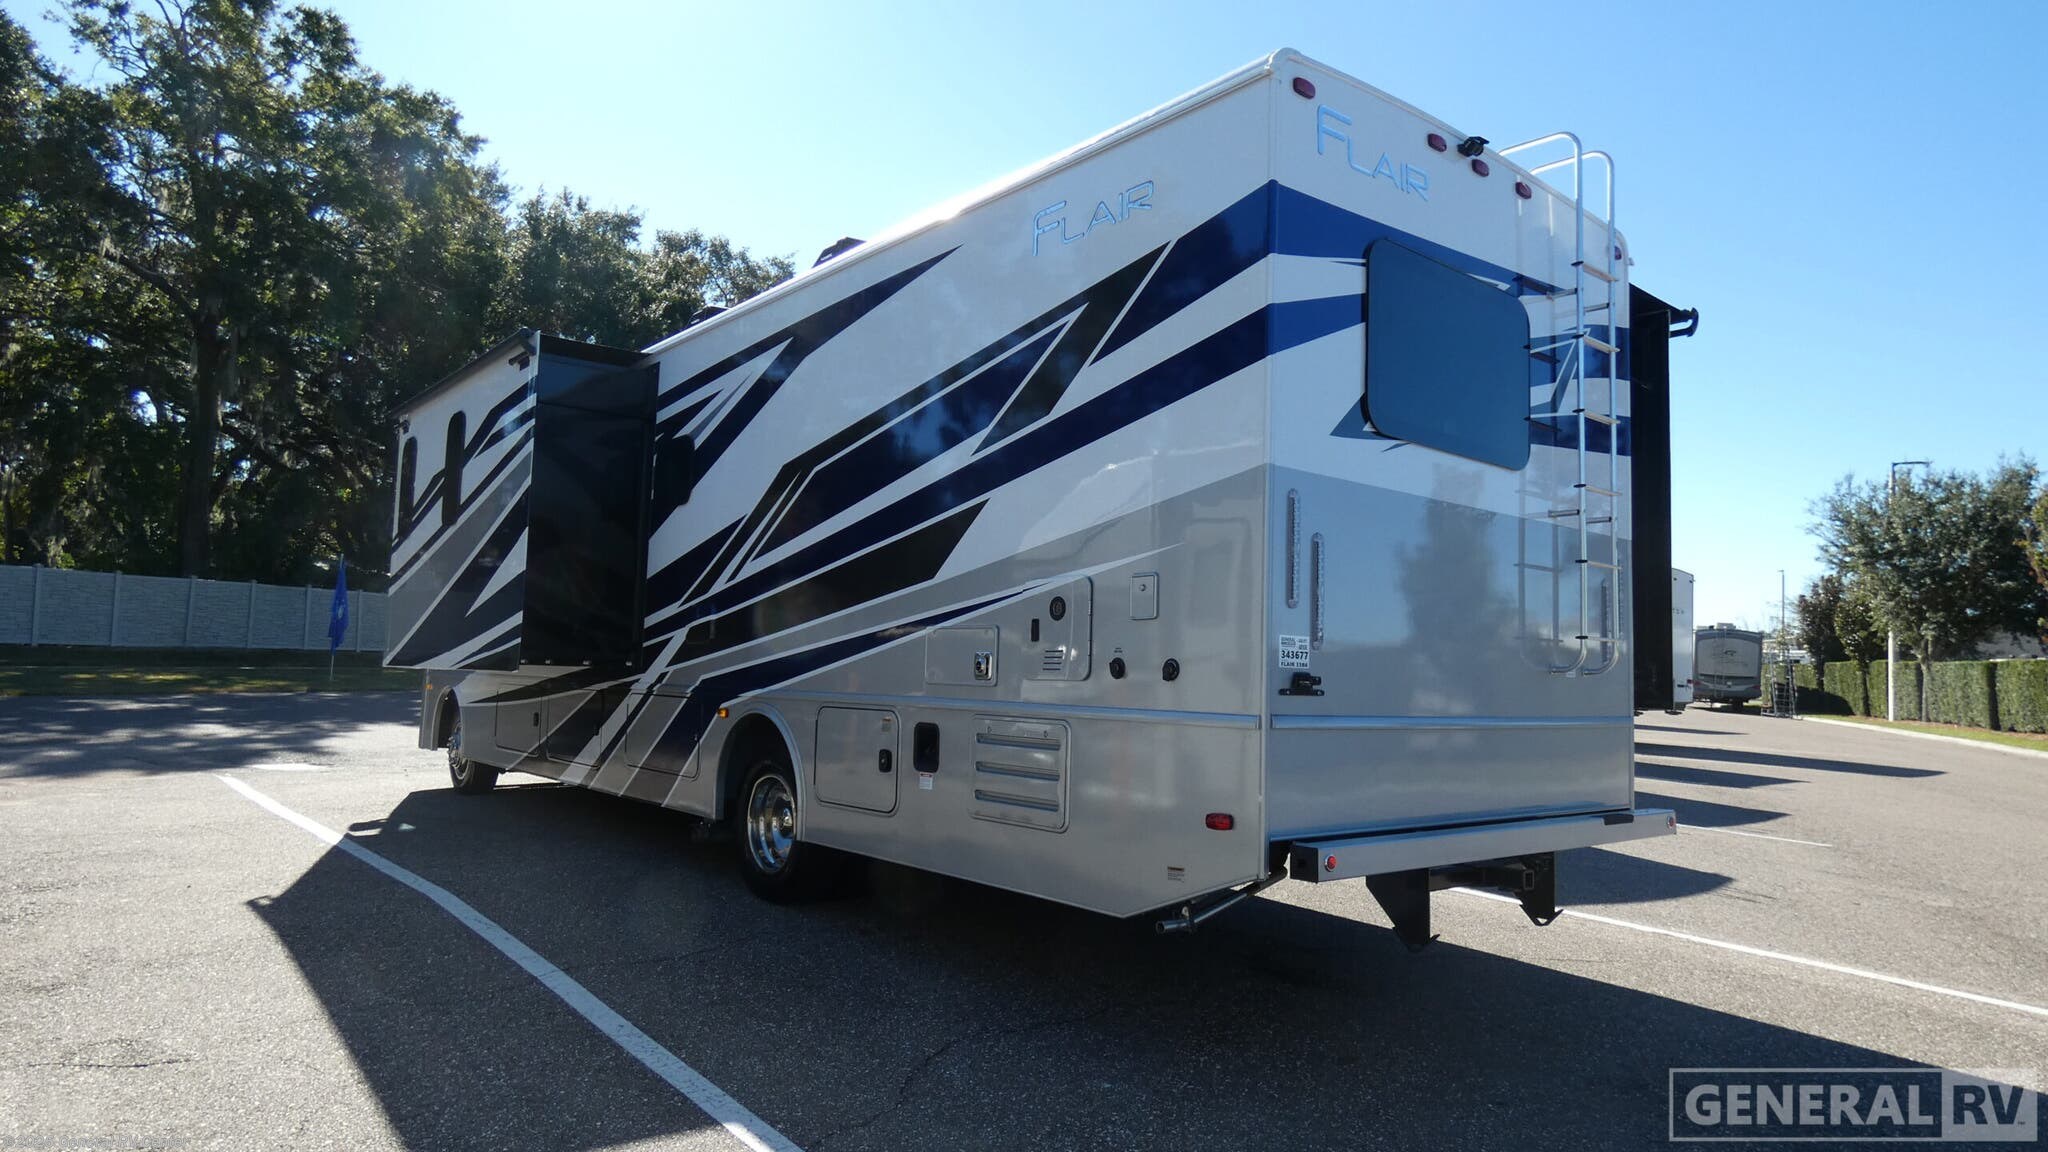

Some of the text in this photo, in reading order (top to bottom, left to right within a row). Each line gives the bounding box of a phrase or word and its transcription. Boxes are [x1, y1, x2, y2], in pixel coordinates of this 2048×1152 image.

[1317, 104, 1430, 202] FLAIR
[1032, 180, 1154, 256] FLAIR
[1281, 650, 1308, 659] 343677
